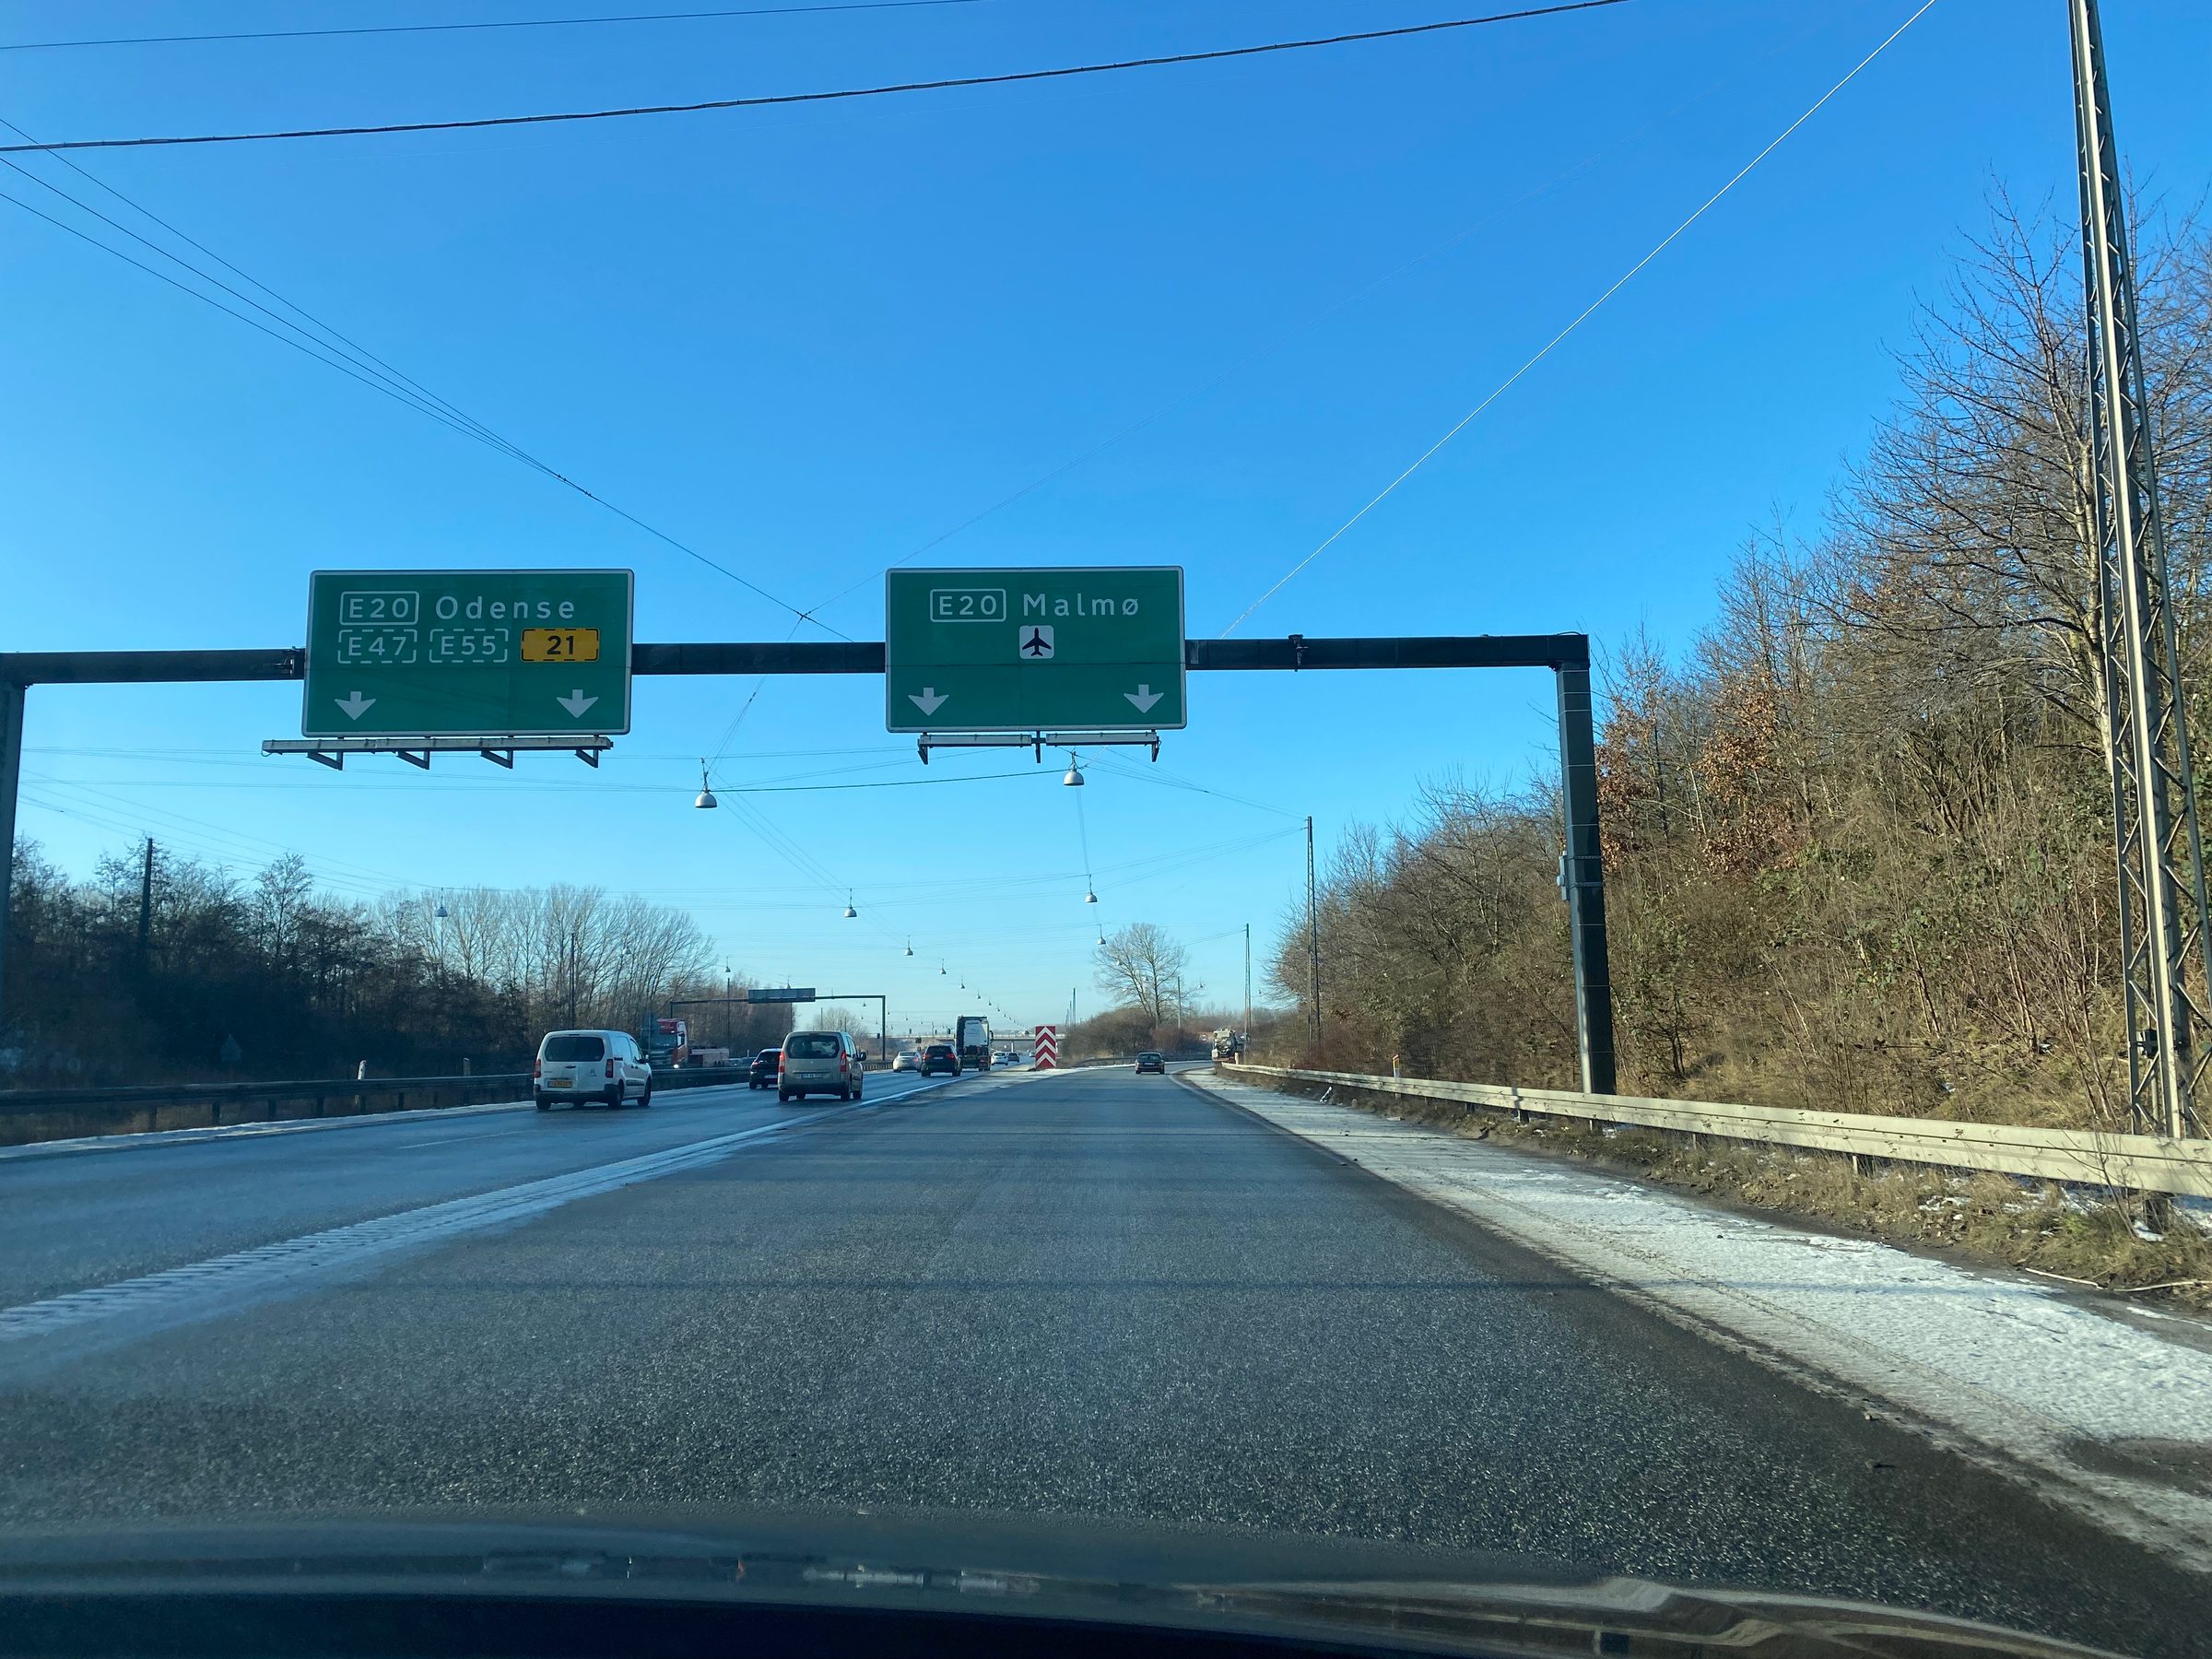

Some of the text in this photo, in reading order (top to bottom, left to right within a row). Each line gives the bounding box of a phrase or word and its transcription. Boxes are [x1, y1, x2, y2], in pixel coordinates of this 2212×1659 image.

[348, 595, 575, 619] E20 Odense
[938, 593, 1138, 616] E20 Malmø
[347, 635, 575, 656] E47 E55 21
